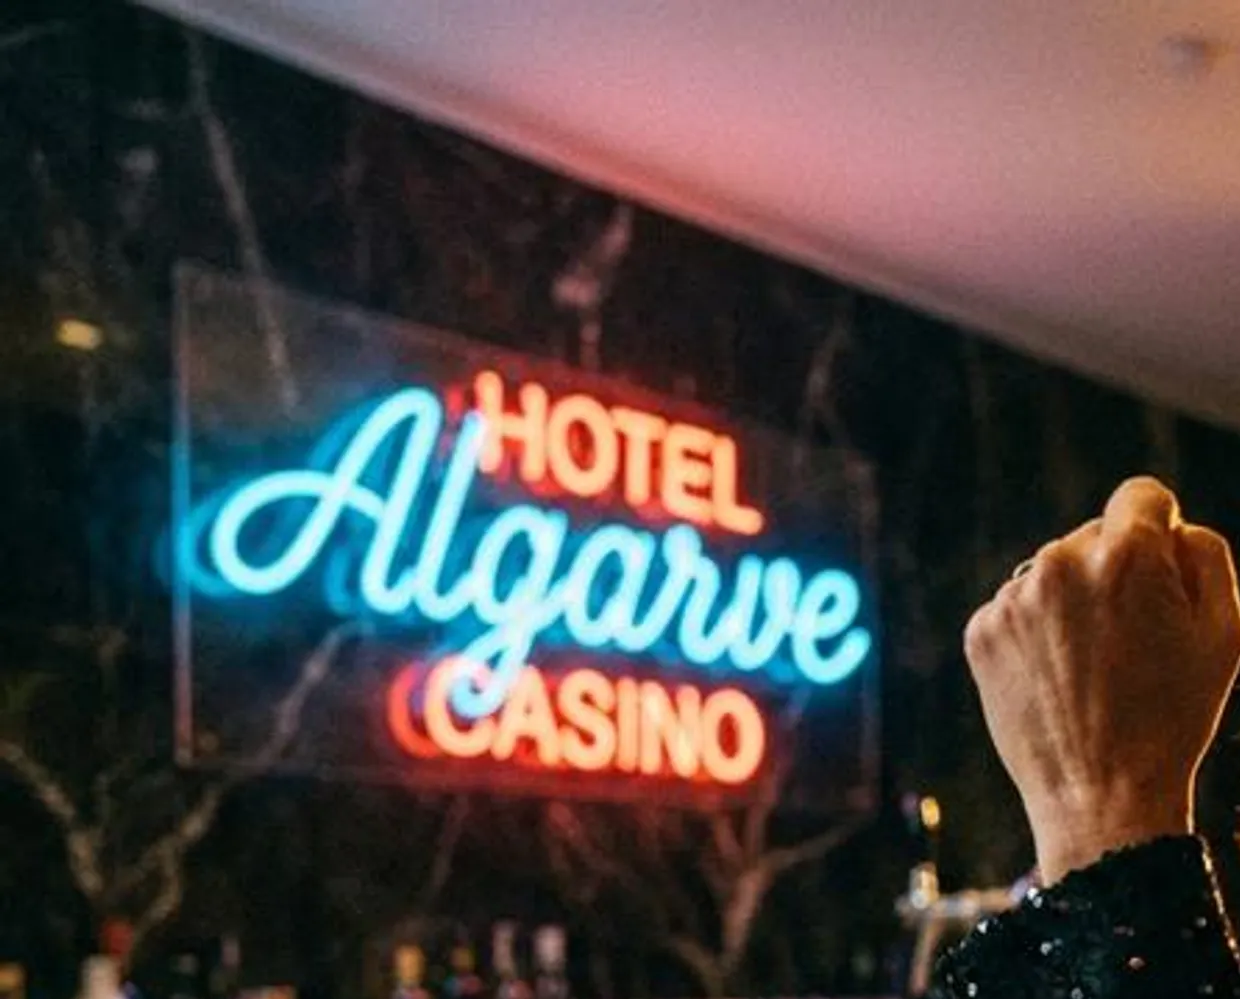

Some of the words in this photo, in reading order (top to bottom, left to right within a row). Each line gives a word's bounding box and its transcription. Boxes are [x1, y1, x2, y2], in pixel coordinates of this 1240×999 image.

[474, 369, 764, 535] HOTEL
[210, 387, 871, 719] Algarve
[423, 653, 766, 785] CASINO
